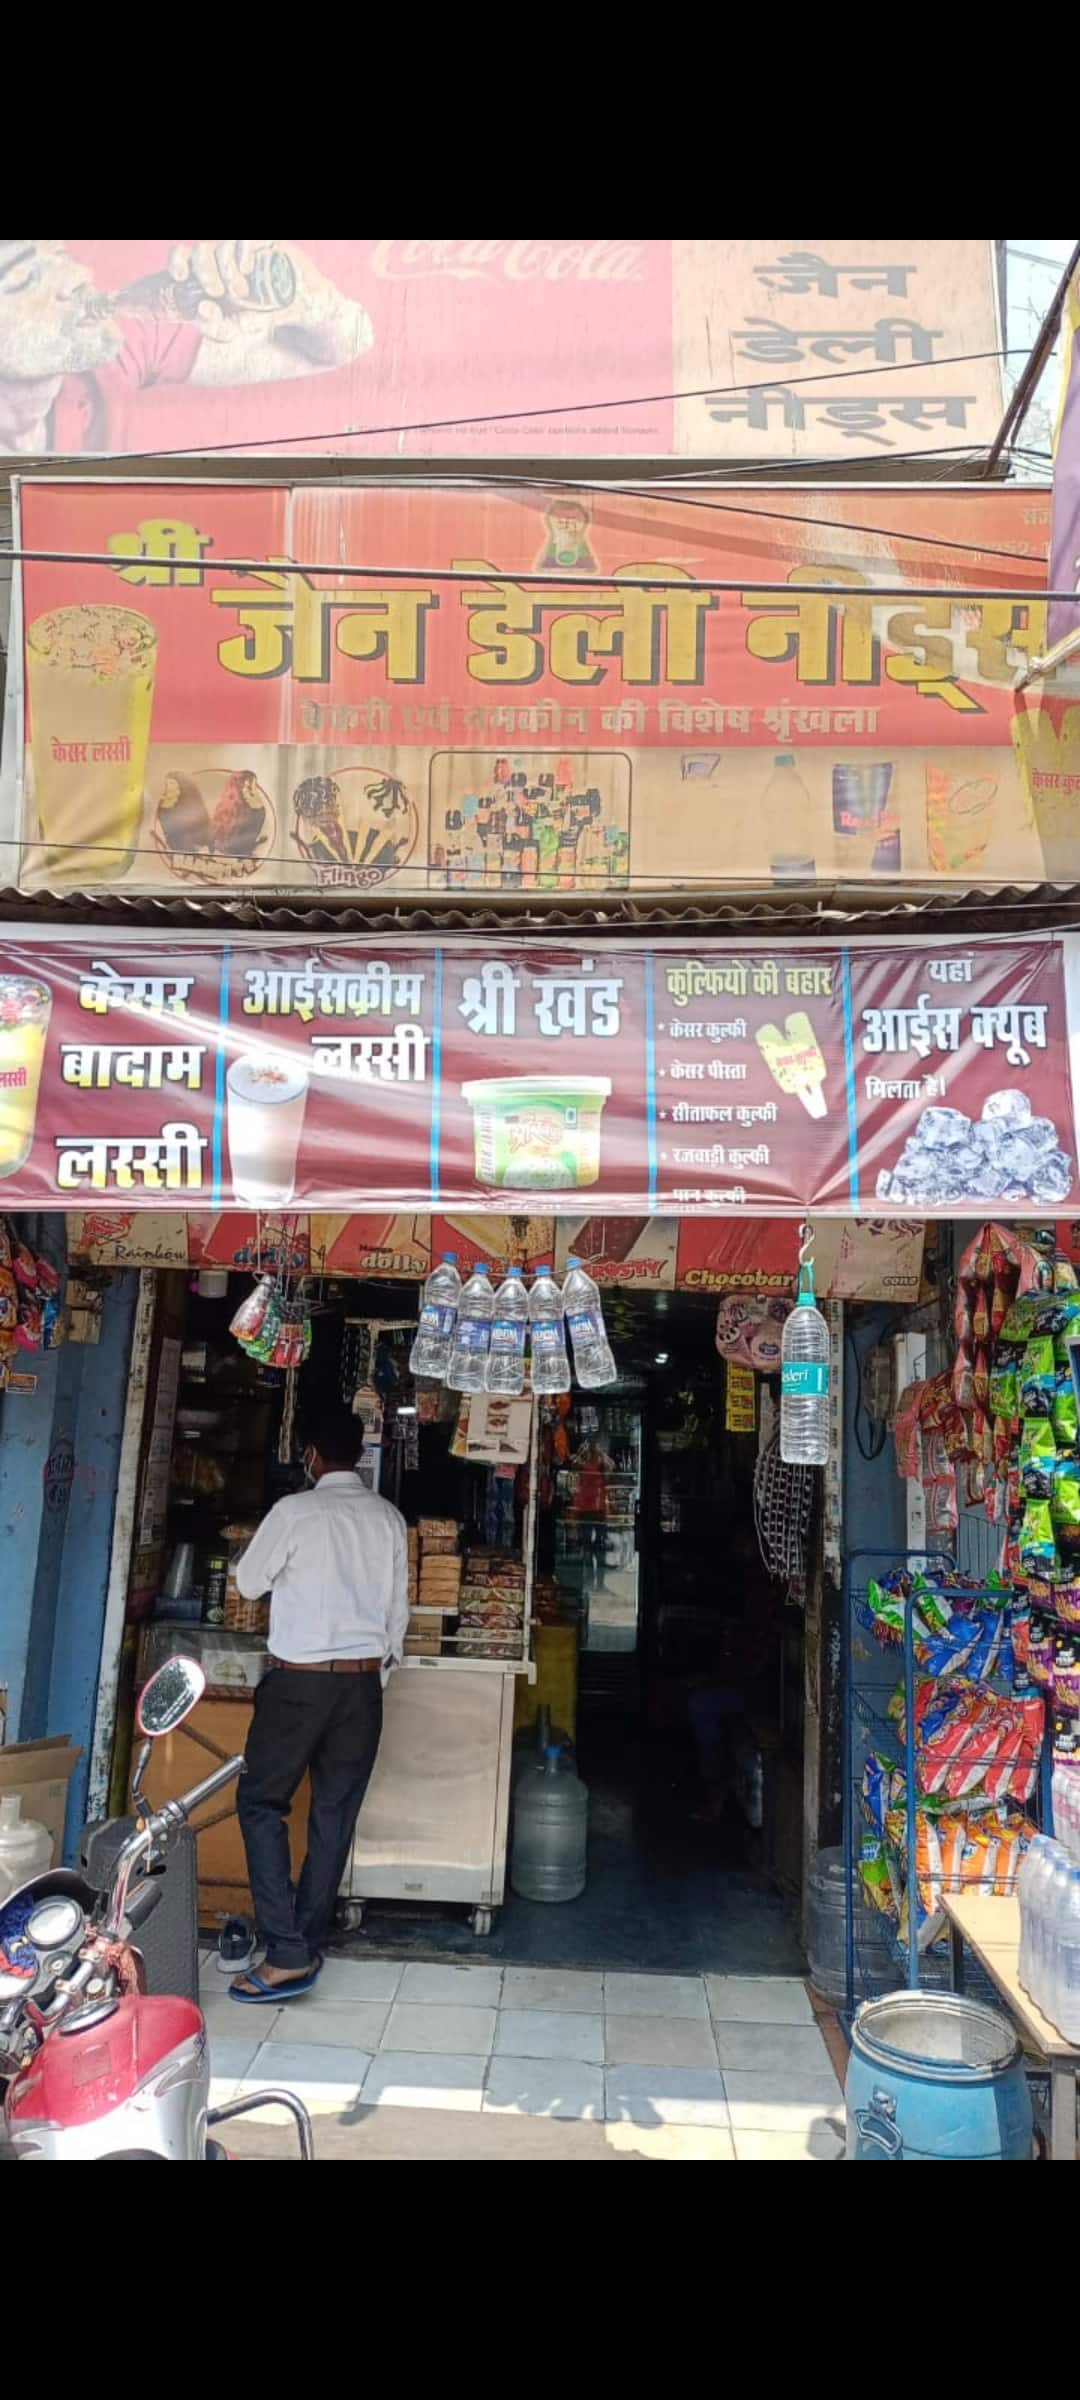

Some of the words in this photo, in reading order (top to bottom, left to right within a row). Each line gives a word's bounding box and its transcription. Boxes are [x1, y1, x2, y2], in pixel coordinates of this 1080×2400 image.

[754, 252, 916, 297] जैन
[733, 318, 943, 363] डेली
[705, 386, 976, 447] नीड्स
[107, 519, 210, 586] श्री
[211, 557, 436, 684] जैन
[460, 560, 717, 684] डेली
[464, 698, 588, 734] नमकीन
[600, 698, 648, 734] की
[657, 697, 752, 734] विशेष
[51, 736, 88, 763] केसर
[92, 735, 130, 762] लस्सी
[319, 868, 382, 888] Flingo
[751, 960, 779, 996] की
[784, 967, 832, 996] बहार
[928, 951, 976, 983] यहां
[79, 961, 195, 1017] केसर
[243, 958, 426, 1024] आईसक्रीम
[457, 960, 521, 1036] श्री
[532, 959, 624, 1037] खंड
[669, 1018, 702, 1039] केसर
[705, 1018, 747, 1043] कुल्फी
[861, 994, 963, 1059] आईस
[970, 1004, 1048, 1067] क्यूब
[60, 1045, 207, 1088] बादाम
[312, 1024, 431, 1082] लस्सी
[670, 1059, 704, 1080] केसर
[707, 1059, 747, 1080] पीस्ता
[865, 1075, 921, 1100] मिलता
[671, 1102, 732, 1123] सीताफल
[736, 1102, 778, 1128] कुल्फी
[56, 1123, 208, 1190] लस्सी
[728, 1145, 770, 1170] कुल्फी
[672, 1188, 701, 1203] पान
[704, 1186, 748, 1208] कुल्फी
[114, 1240, 186, 1261] Rainbow
[583, 1257, 668, 1281] ROSTY
[684, 1268, 796, 1289] Chocobar
